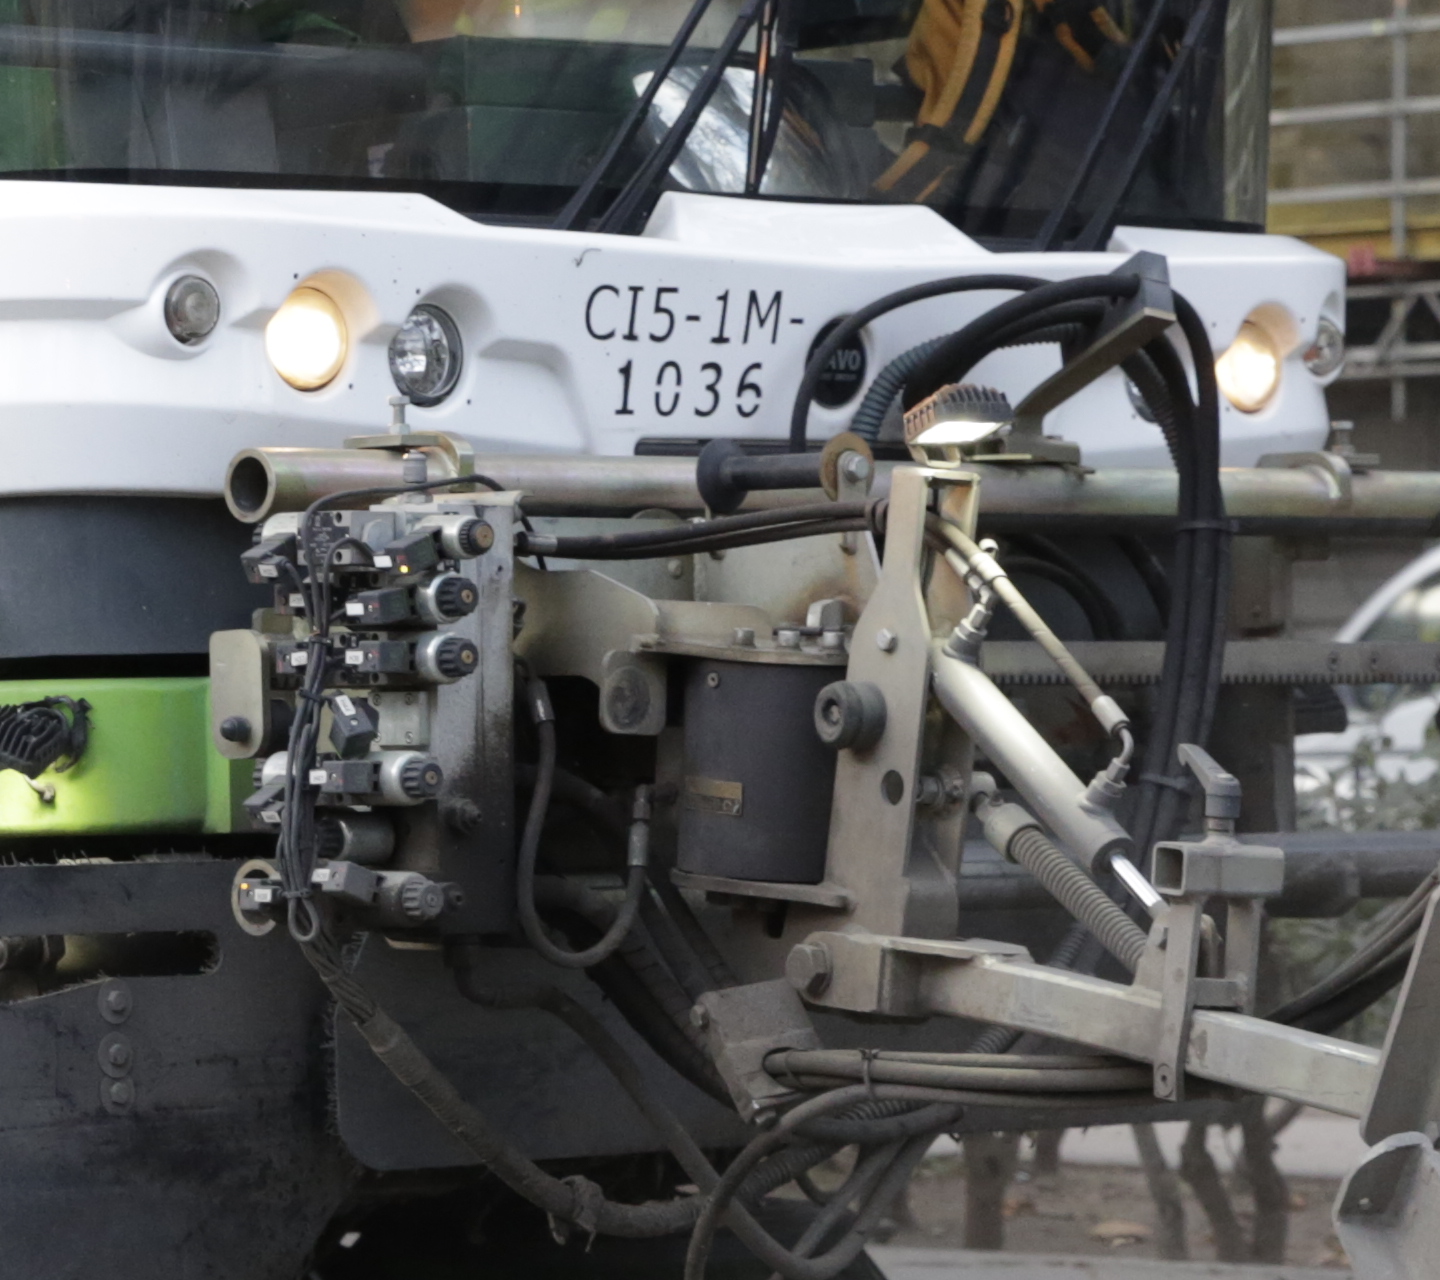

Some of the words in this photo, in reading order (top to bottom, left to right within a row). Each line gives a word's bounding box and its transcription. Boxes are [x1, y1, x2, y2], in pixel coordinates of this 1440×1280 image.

[584, 284, 805, 346] CI5-1M-
[615, 360, 763, 418] 1036
[823, 348, 862, 372] AVO
